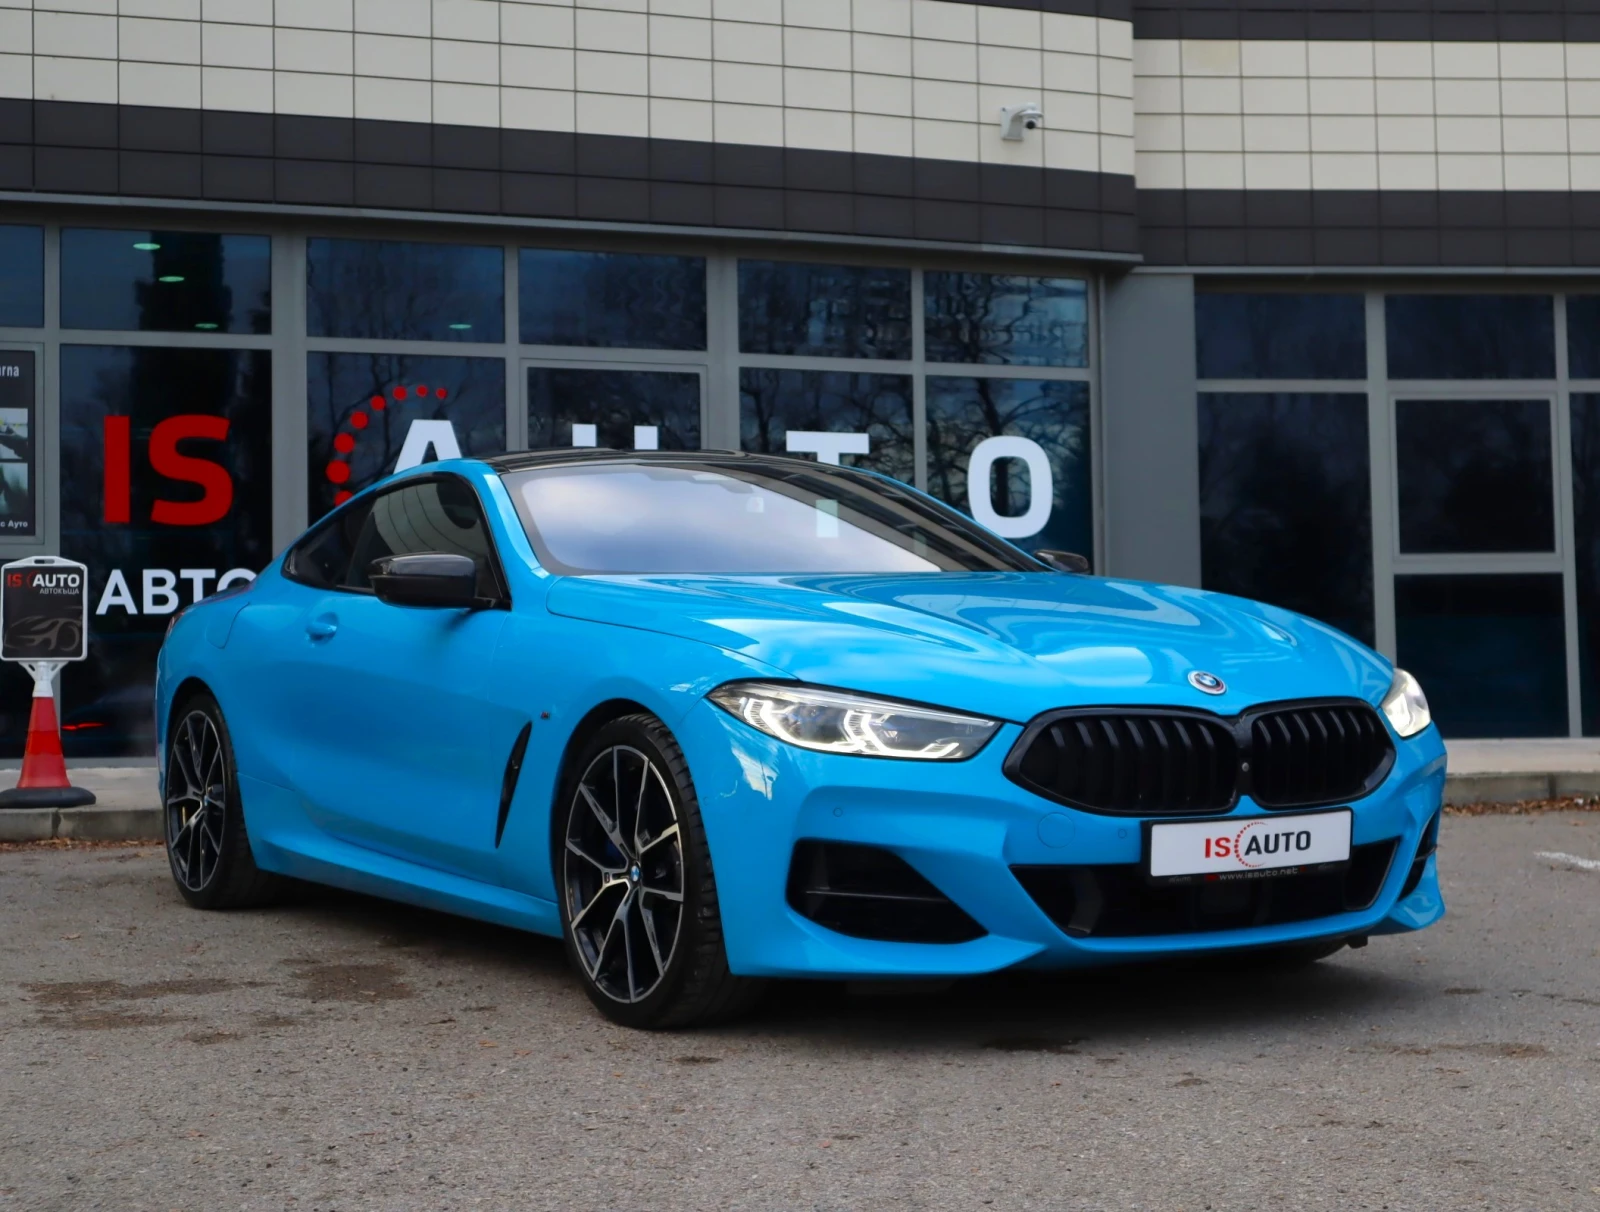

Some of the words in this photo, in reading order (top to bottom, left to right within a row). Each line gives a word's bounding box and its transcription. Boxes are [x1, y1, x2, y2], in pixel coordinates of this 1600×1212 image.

[0, 365, 20, 377] rna
[103, 414, 234, 526] IS
[393, 418, 1054, 539] TO
[7, 573, 23, 588] IS
[32, 573, 80, 588] AUTO
[1205, 837, 1231, 858] IS
[1244, 830, 1312, 856] AUTO
